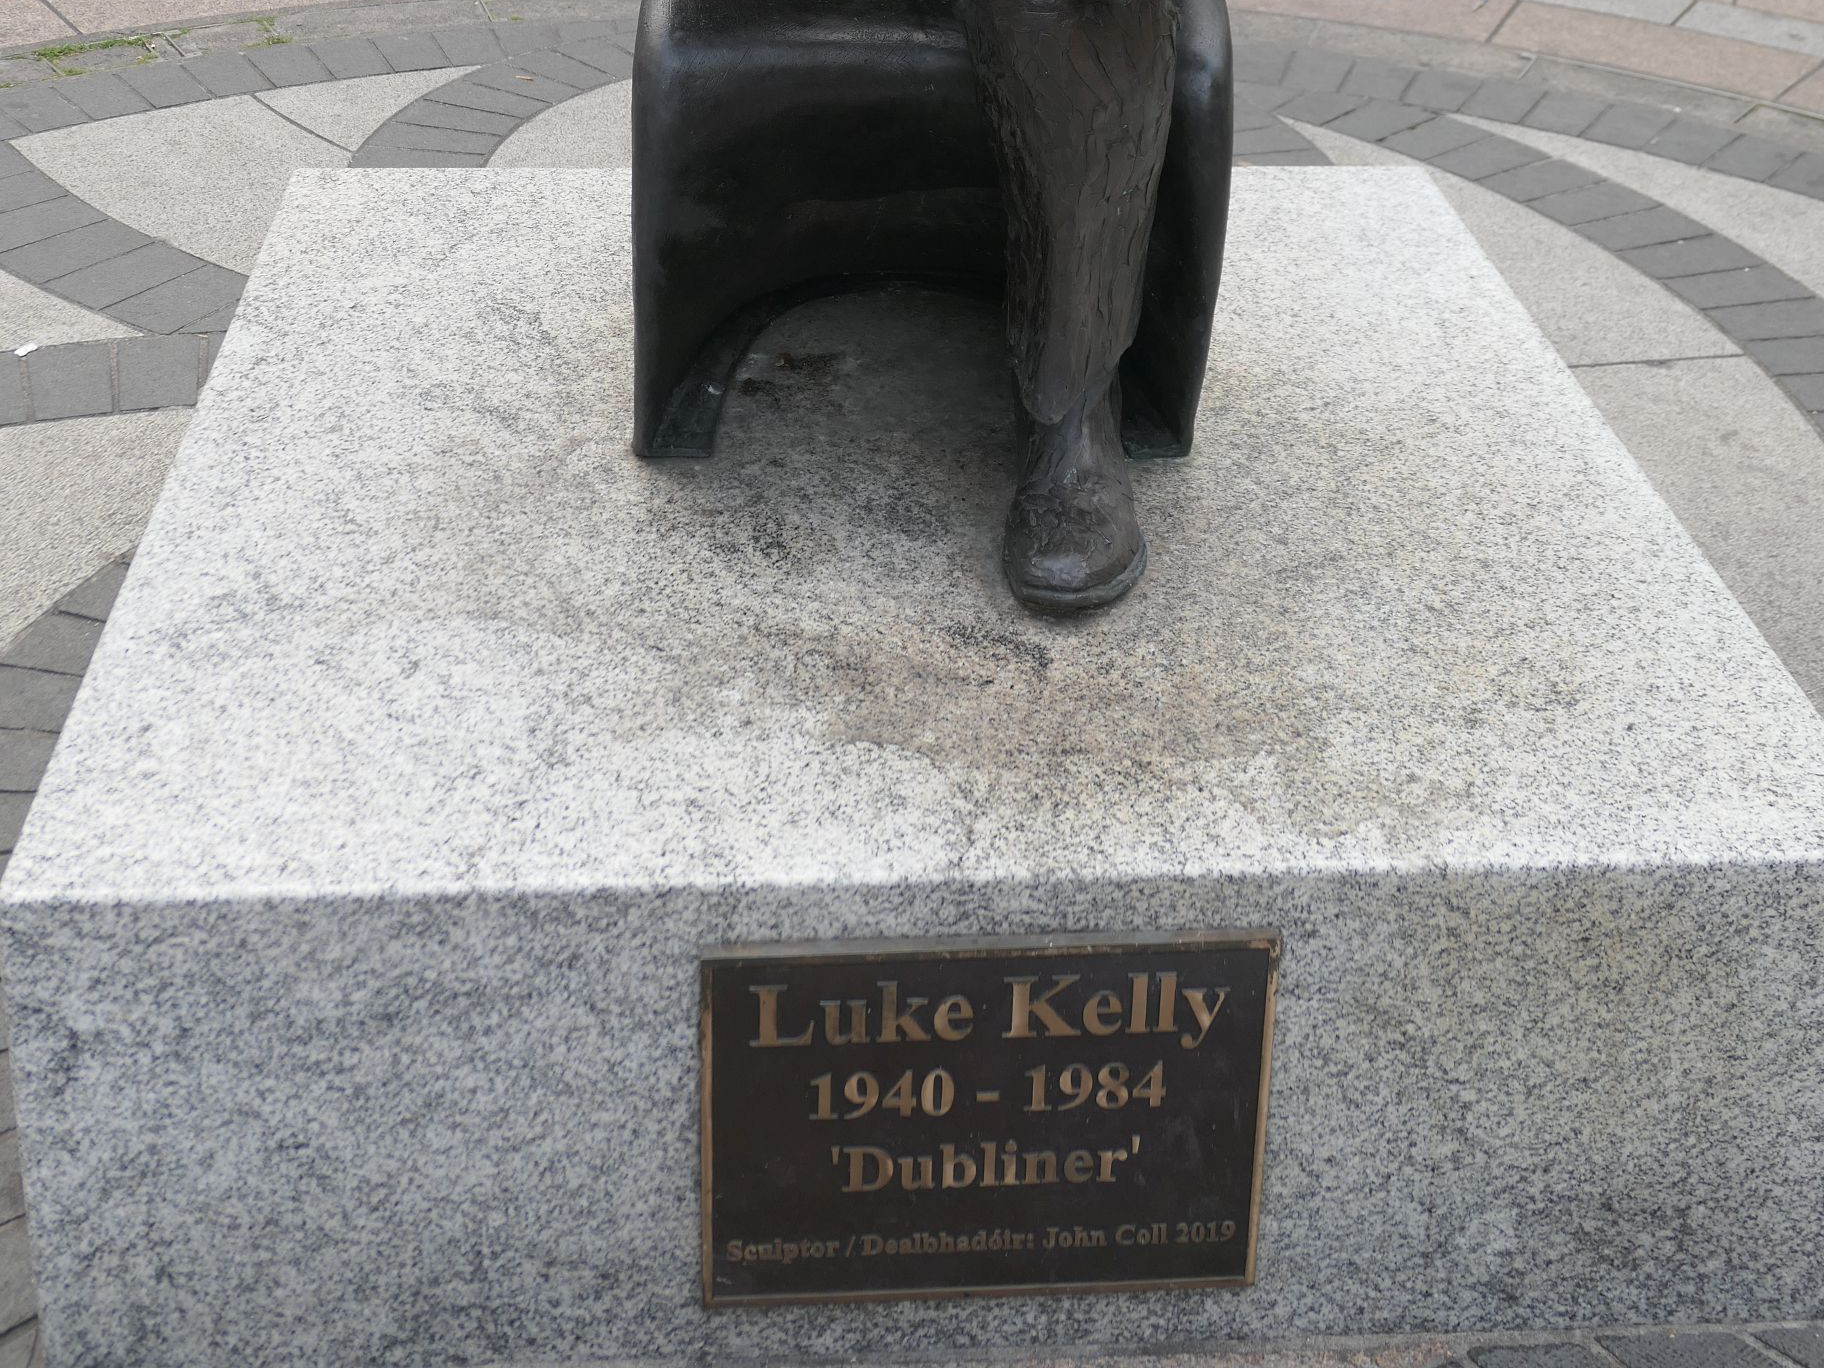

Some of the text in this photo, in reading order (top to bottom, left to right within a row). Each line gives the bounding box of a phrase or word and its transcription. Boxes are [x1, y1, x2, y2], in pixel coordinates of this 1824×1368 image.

[748, 971, 1231, 1049] Luke Kelly
[808, 1066, 955, 1120] 1940
[1023, 1059, 1167, 1113] 1984
[830, 1134, 1142, 1192] 'Dubliner'
[725, 1238, 841, 1265] Sculptor
[844, 1235, 857, 1259] /
[1042, 1226, 1108, 1249] John
[1115, 1222, 1169, 1246] Coll
[1175, 1220, 1237, 1244] 2019
